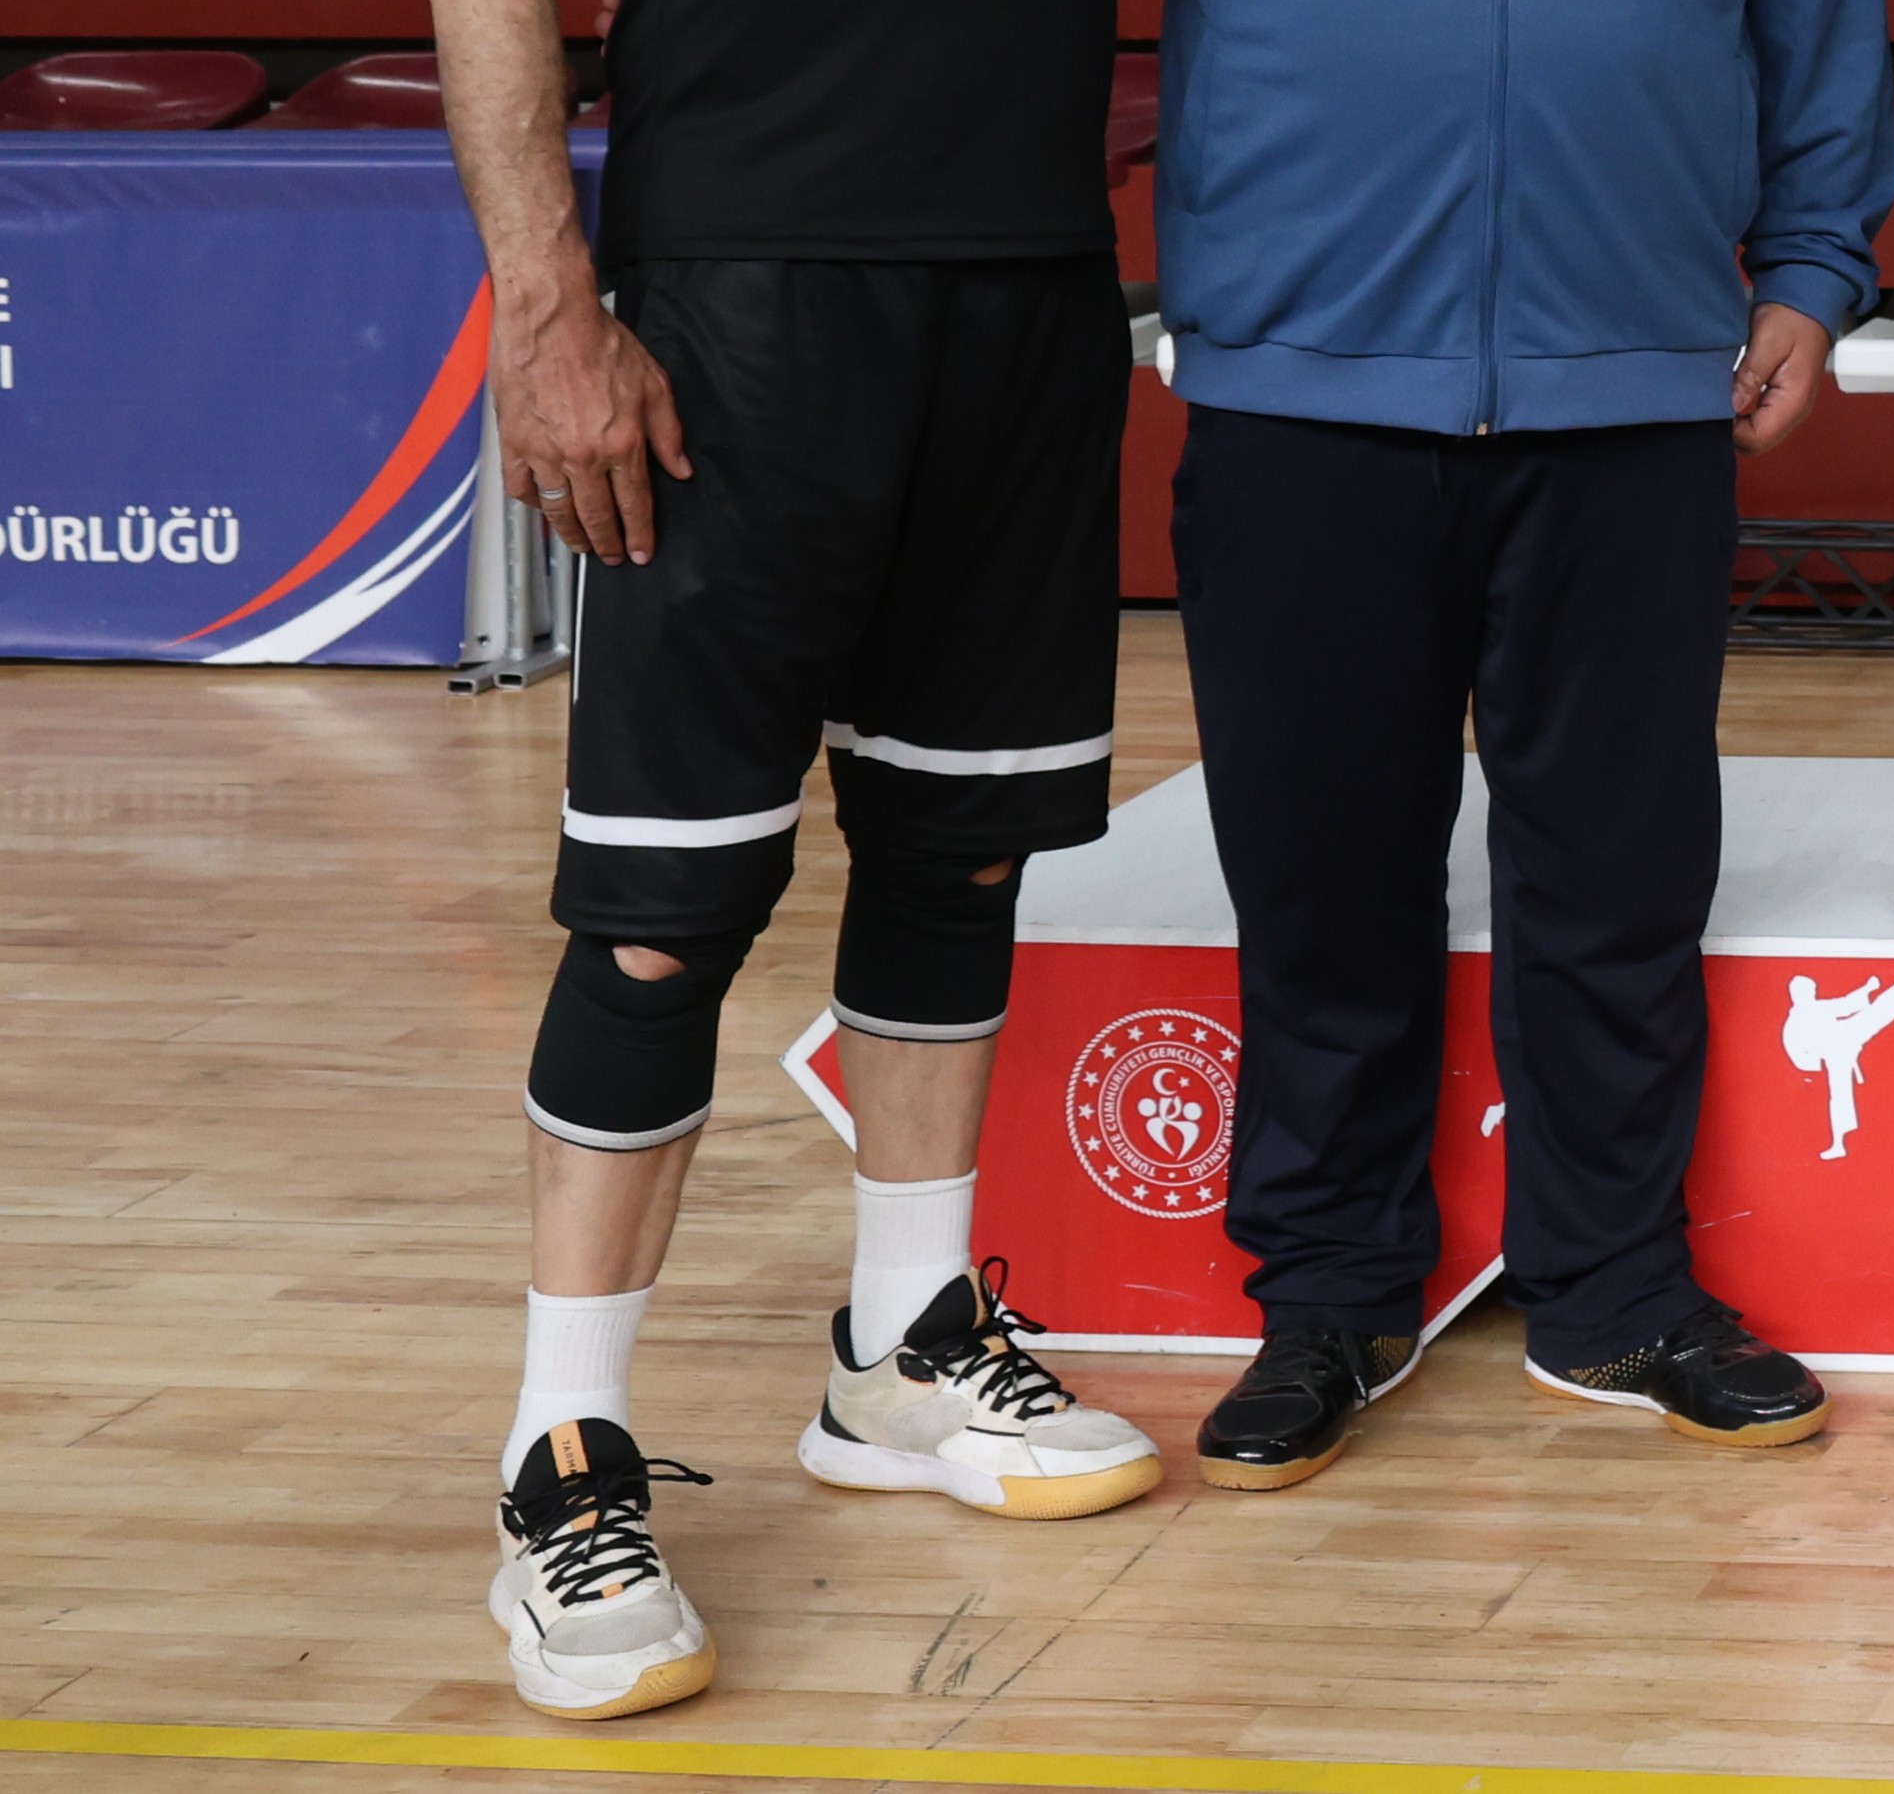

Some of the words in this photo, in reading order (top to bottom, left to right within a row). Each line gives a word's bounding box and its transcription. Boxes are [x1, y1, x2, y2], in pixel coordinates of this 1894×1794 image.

[0, 505, 240, 564] ÜRLÜĞÜ
[1148, 1047, 1207, 1068] GENÇLİK
[1205, 1064, 1222, 1082] VE
[1104, 1051, 1148, 1132] CUMHURİYETİ
[1217, 1081, 1235, 1117] SPOR
[1109, 1133, 1157, 1177] TÜRKİYE
[1188, 1120, 1234, 1178] BAKANLIĞI
